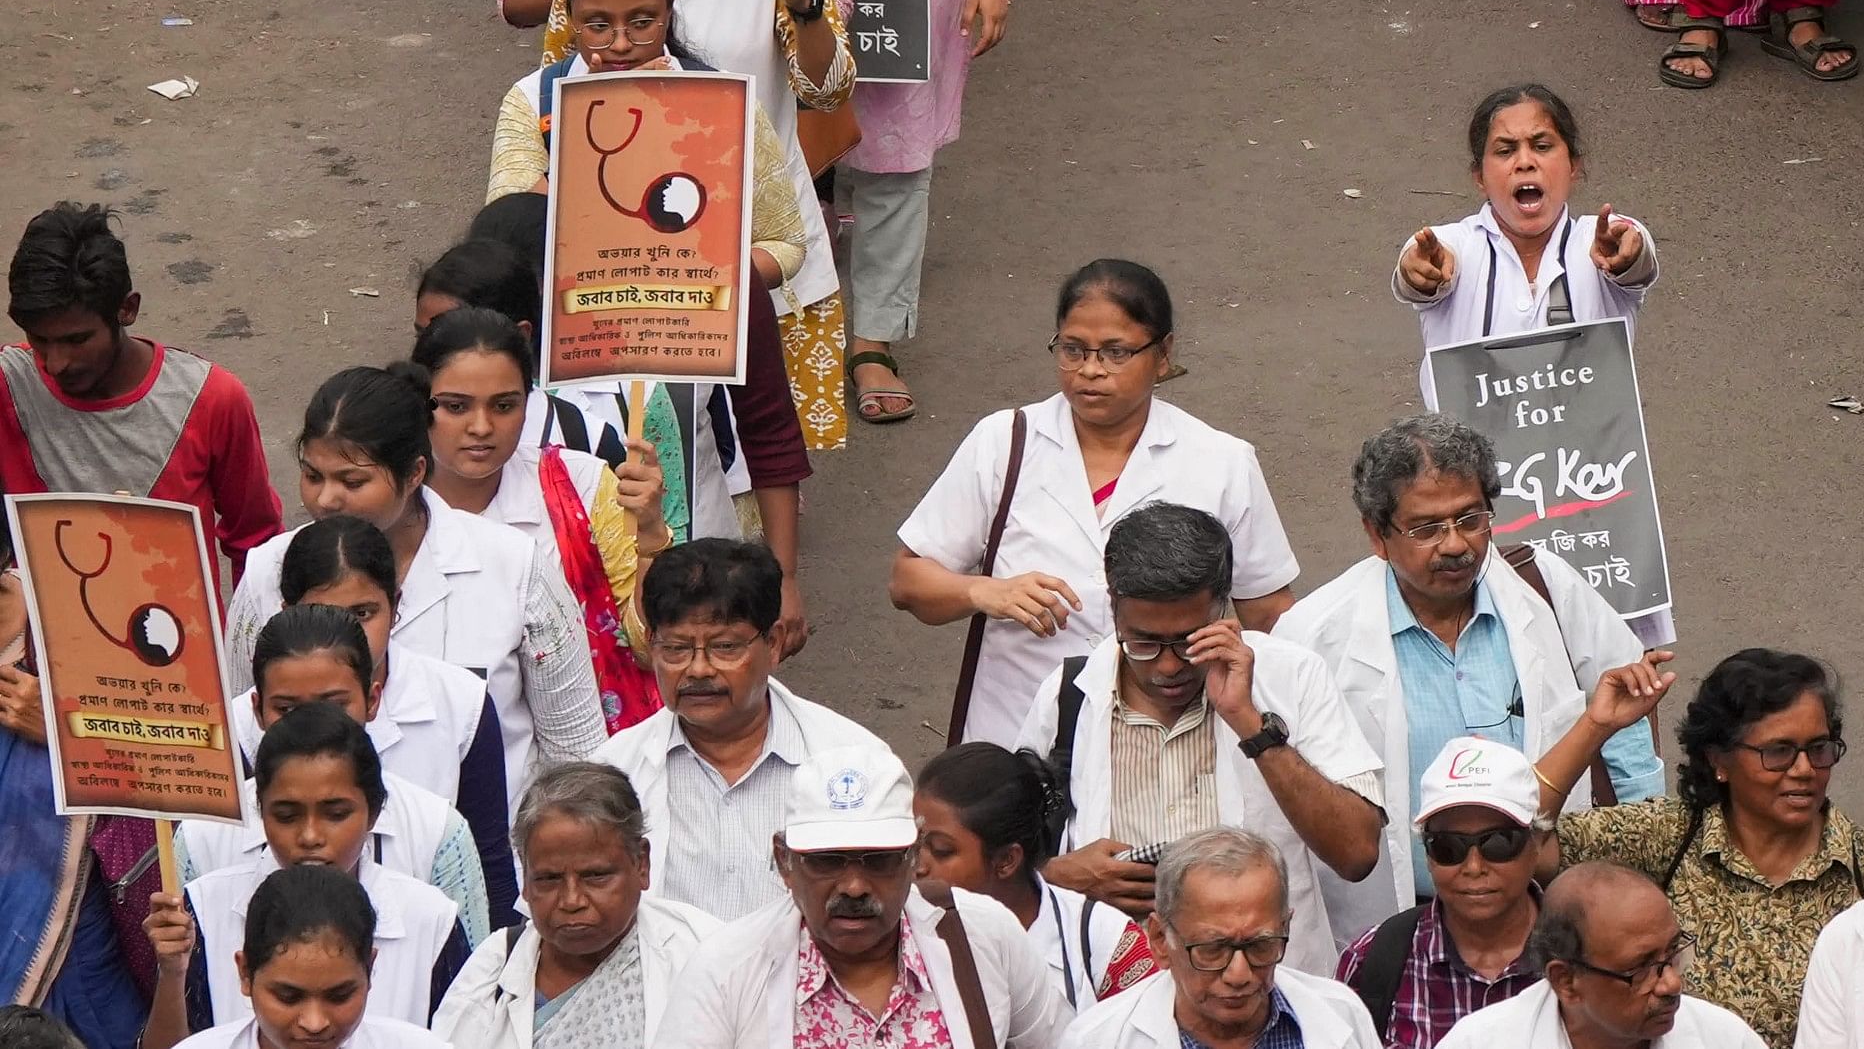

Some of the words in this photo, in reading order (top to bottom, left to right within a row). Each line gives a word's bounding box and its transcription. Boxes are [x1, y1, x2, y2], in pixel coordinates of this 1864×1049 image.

[857, 3, 885, 19] কর
[857, 25, 901, 57] চাই
[597, 248, 640, 259] অভয়ার
[646, 244, 671, 262] খুনি
[676, 248, 697, 259] কে?
[576, 268, 606, 282] প্রমাণ
[610, 265, 651, 279] লোপাট
[656, 267, 679, 279] কার
[685, 266, 719, 279] স্বার্থে?
[576, 291, 613, 306] জবাব
[615, 285, 642, 304] চাই,
[644, 289, 684, 303] জবাব
[1475, 363, 1594, 408] Justice
[1515, 400, 1566, 428] for
[1551, 529, 1576, 553] জি
[1579, 529, 1610, 550] কর
[1582, 554, 1636, 588] চাই
[82, 718, 120, 734] জবাব
[120, 718, 147, 738] চাই,
[146, 724, 185, 739] জবাব
